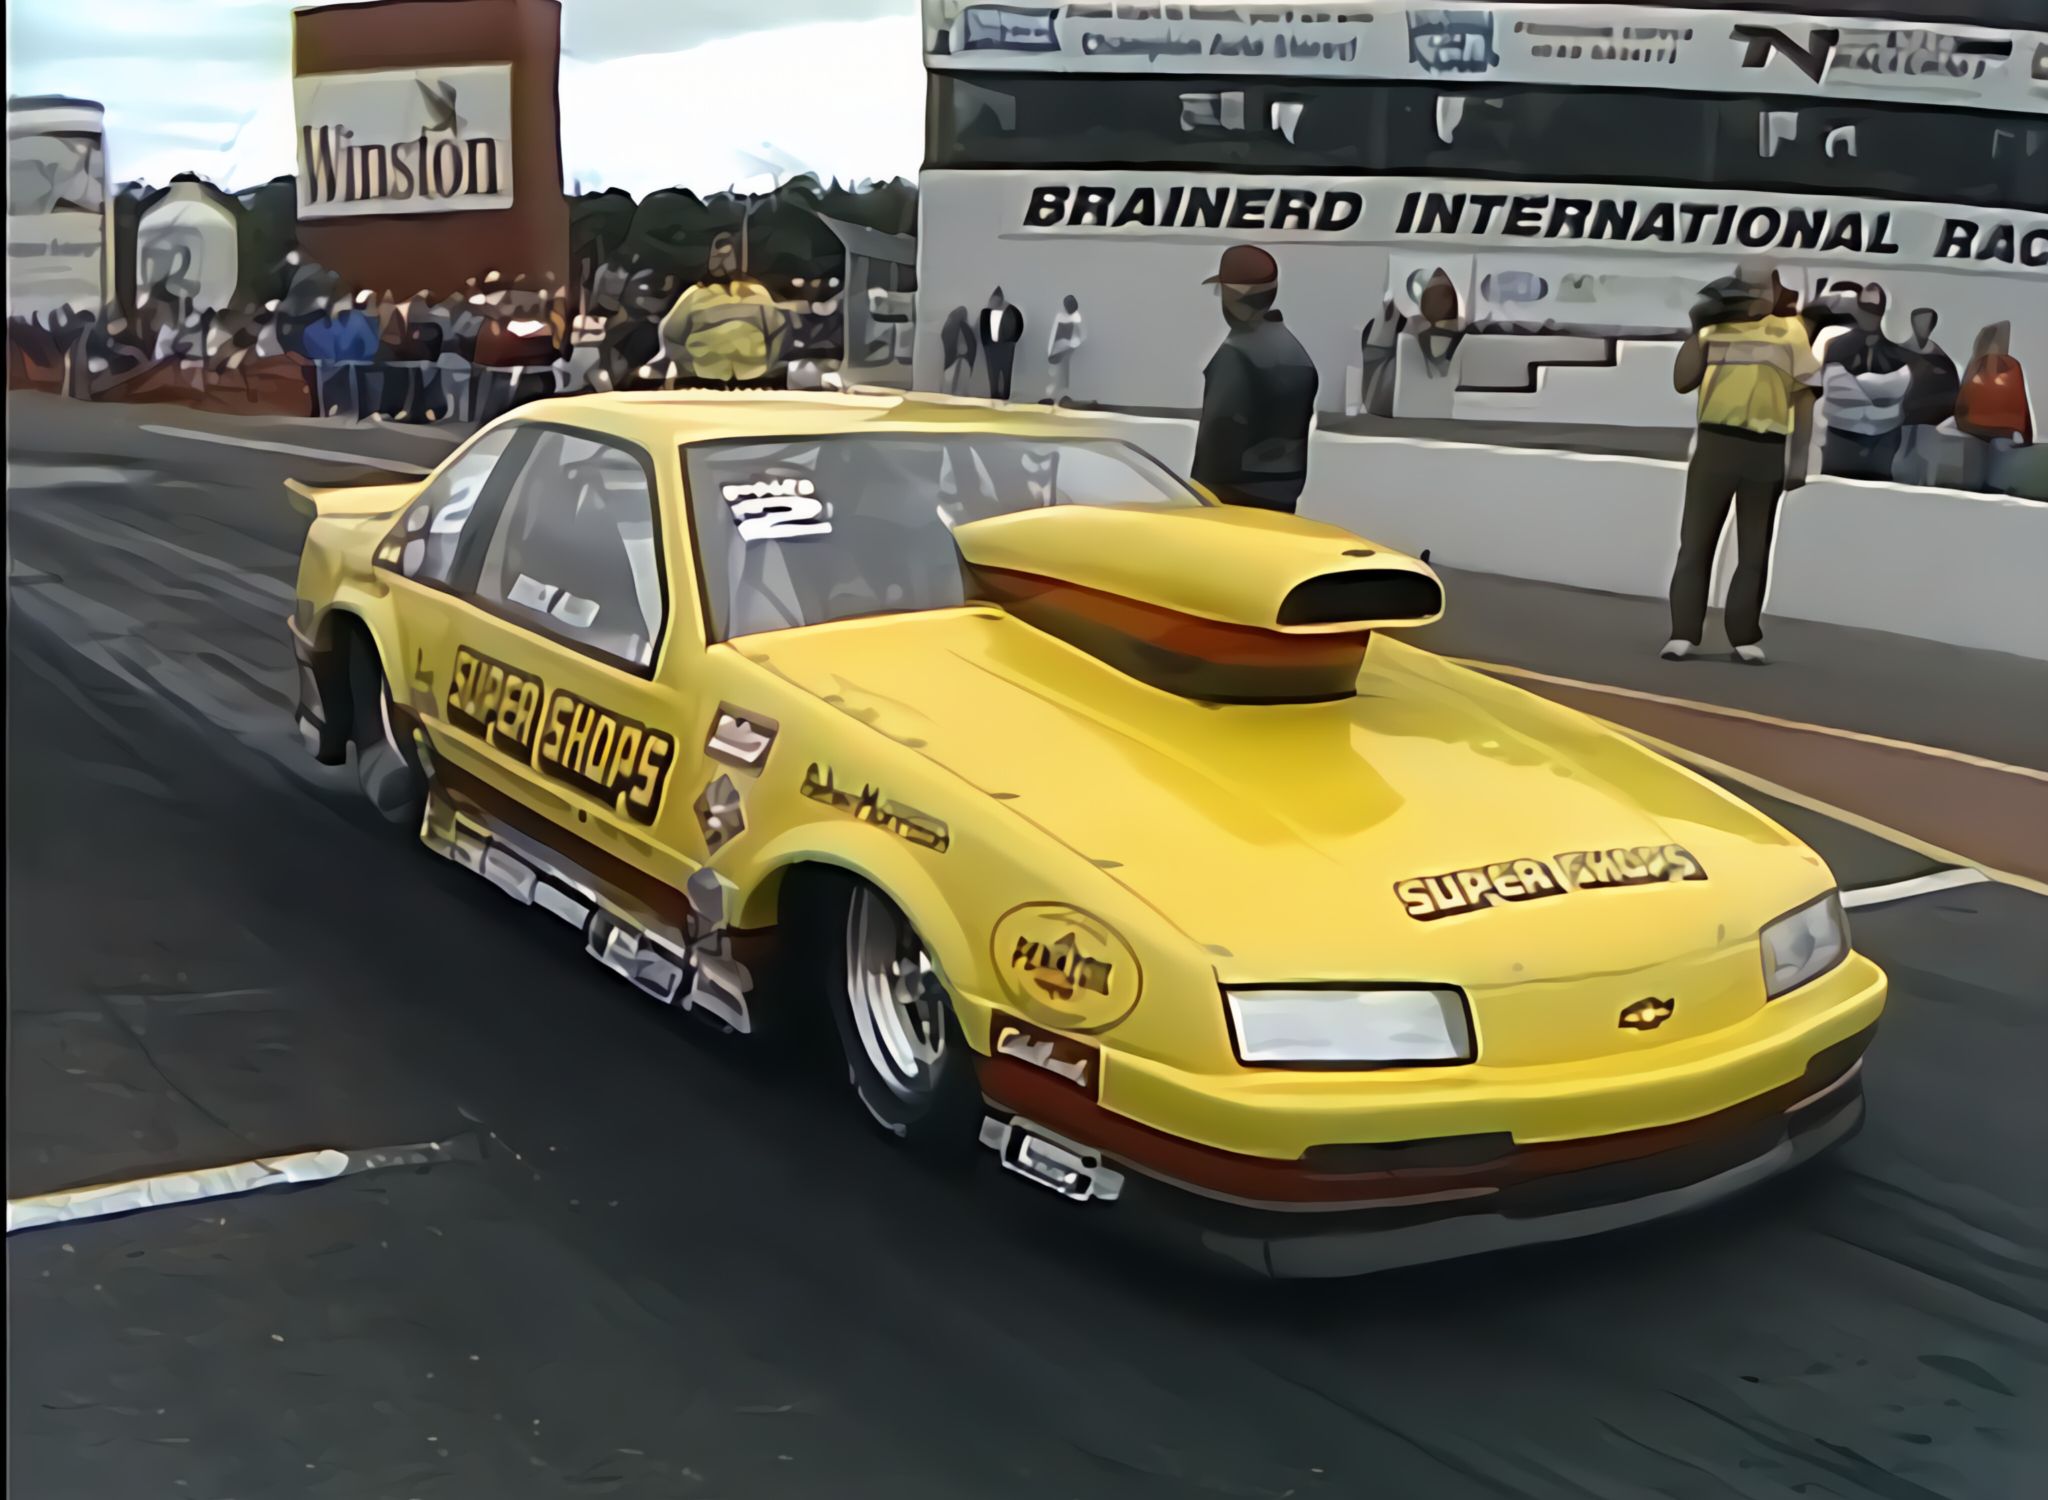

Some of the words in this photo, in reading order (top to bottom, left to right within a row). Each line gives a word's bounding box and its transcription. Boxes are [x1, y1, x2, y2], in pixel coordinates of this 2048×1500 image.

[302, 123, 499, 204] Winston
[1023, 186, 1363, 232] BRAINERD
[1396, 191, 1899, 255] INTERNATIONAL
[448, 645, 544, 765] SUPER
[540, 688, 675, 826] SHOPS
[1394, 858, 1566, 921] SUPER
